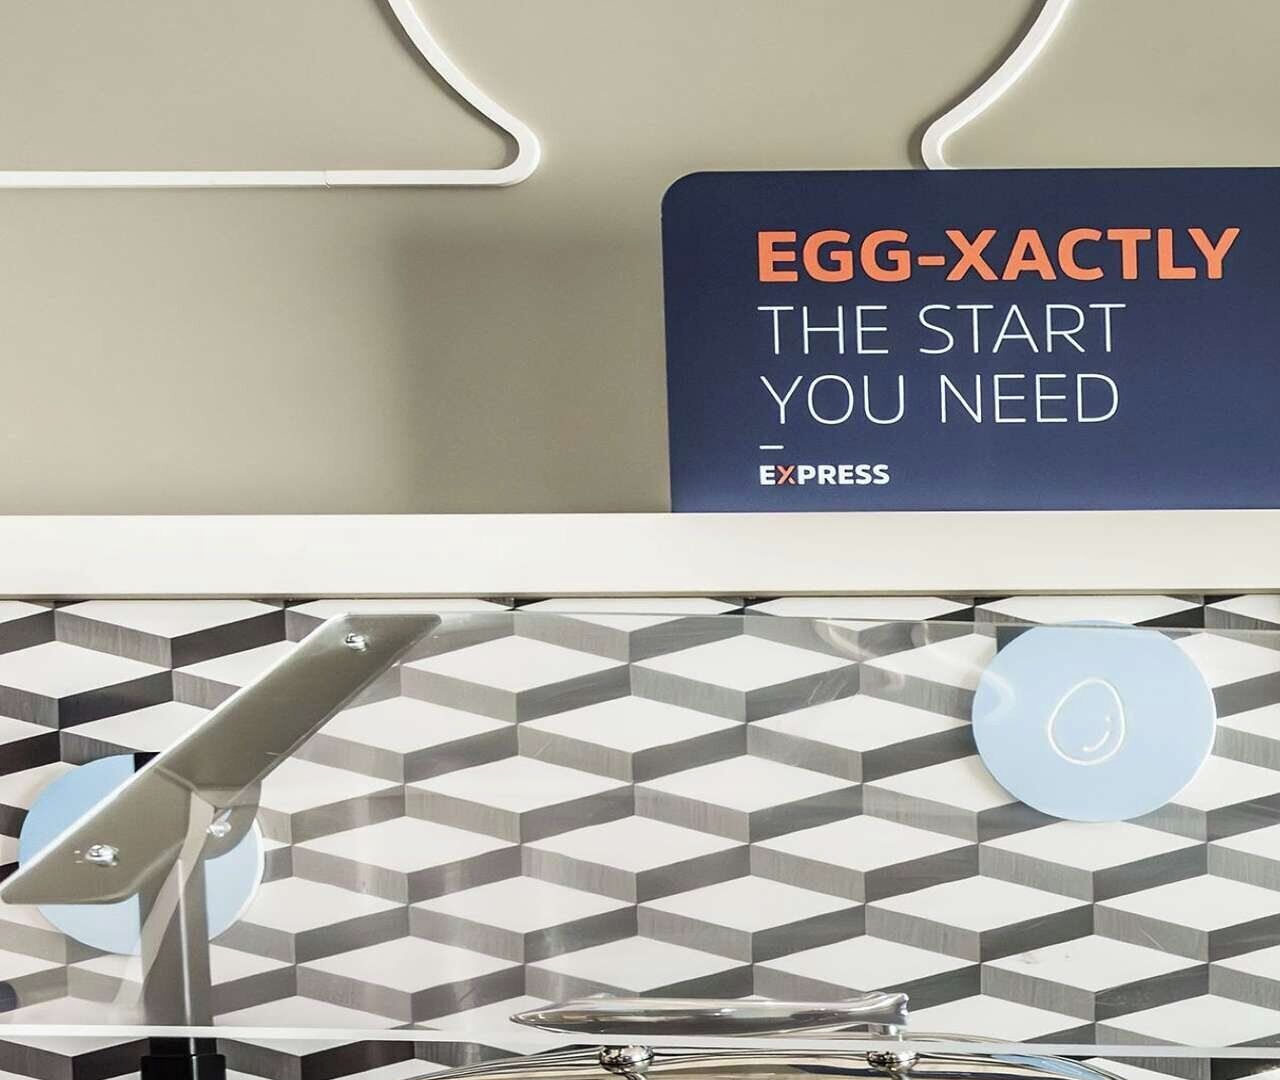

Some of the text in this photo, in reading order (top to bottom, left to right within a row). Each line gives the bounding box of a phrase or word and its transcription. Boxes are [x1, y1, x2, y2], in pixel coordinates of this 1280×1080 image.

[757, 227, 1242, 283] EGG-XACTLY
[757, 302, 1128, 356] THE START
[759, 372, 1121, 426] YOU NEED
[759, 464, 891, 486] EXPRESS
